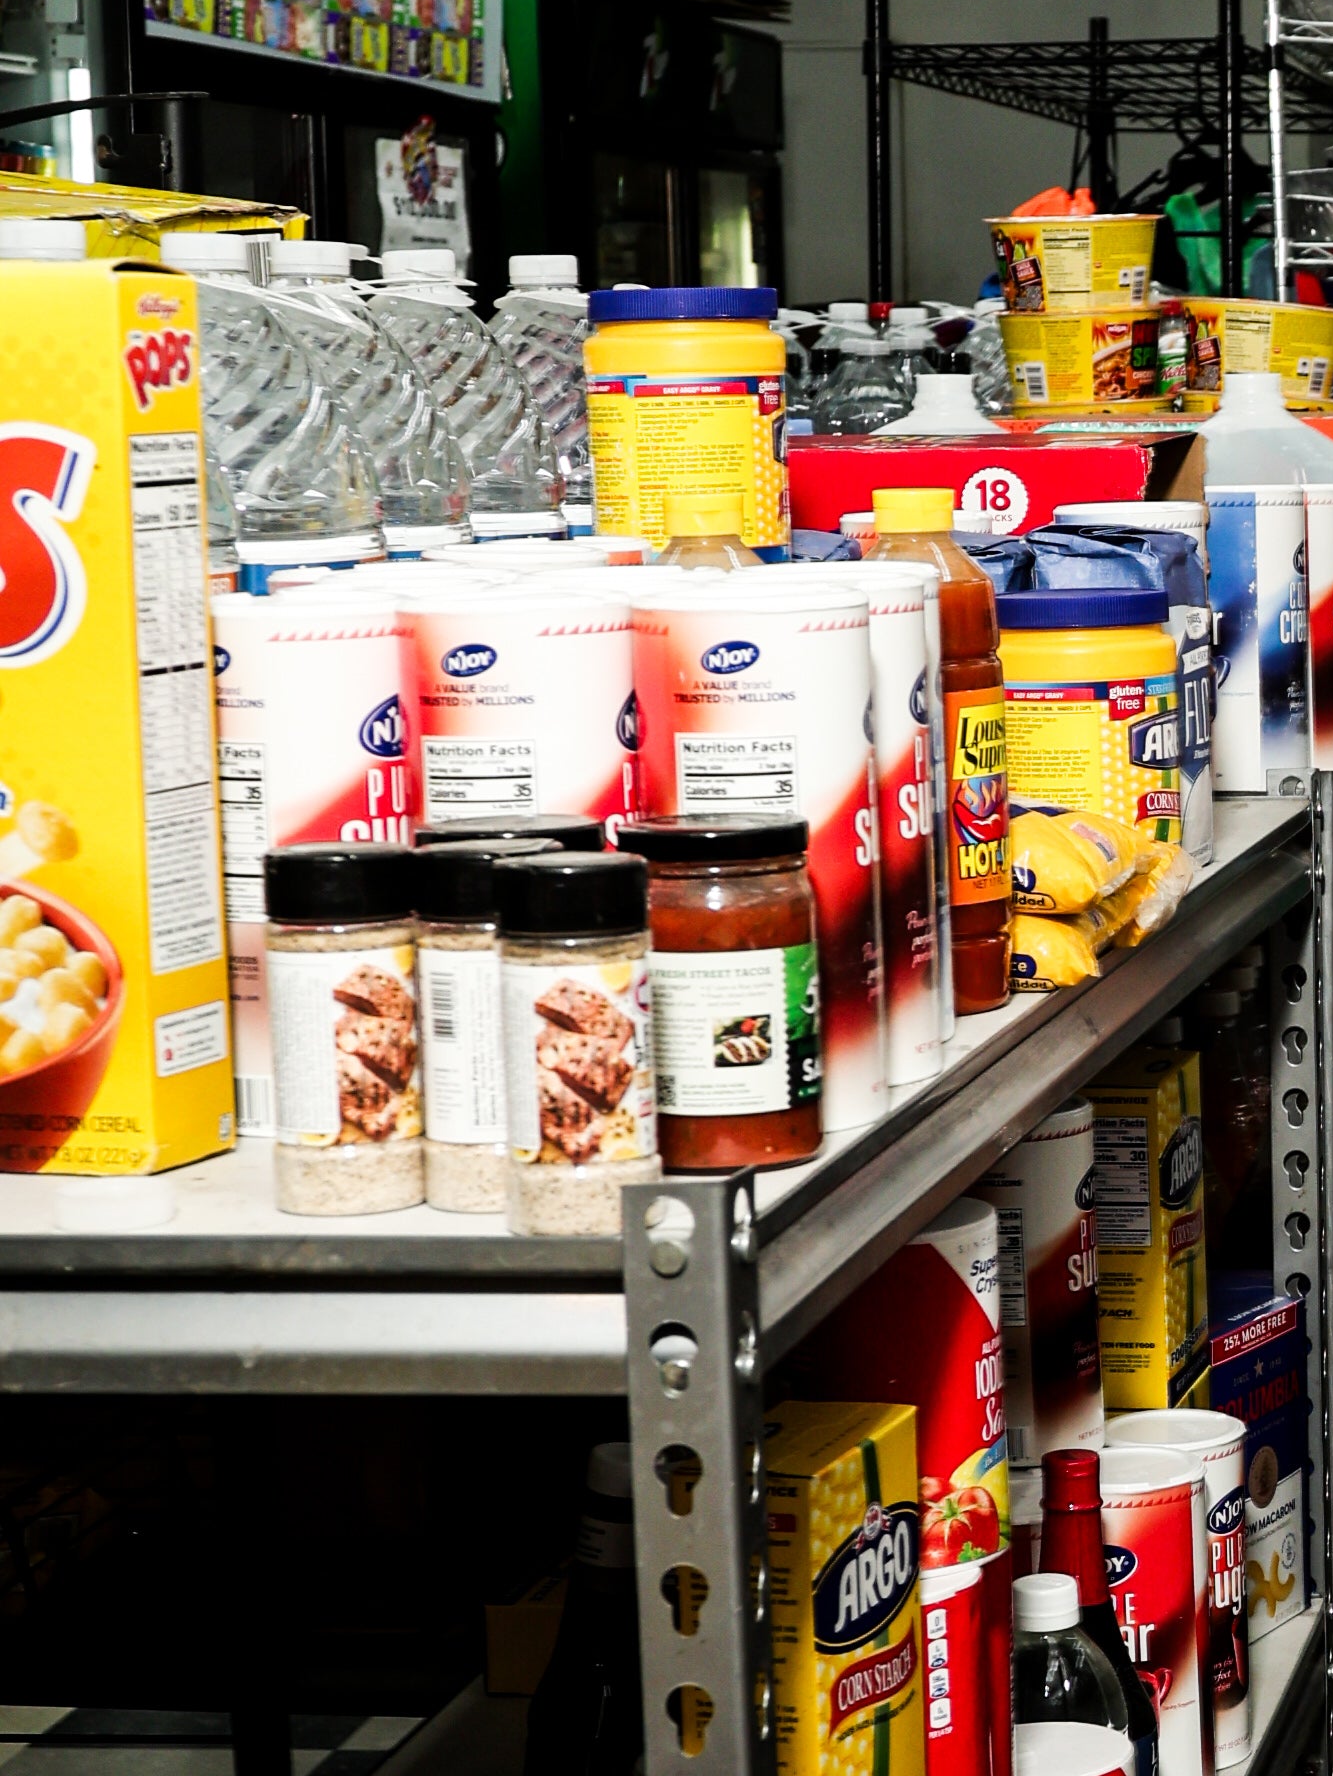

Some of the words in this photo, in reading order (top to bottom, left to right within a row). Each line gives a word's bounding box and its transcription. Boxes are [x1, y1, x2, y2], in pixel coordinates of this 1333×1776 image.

[126, 331, 190, 408] POPS
[976, 480, 1011, 511] 18
[442, 684, 476, 693] VALUE
[703, 681, 738, 690] VALUE
[1109, 685, 1144, 700] gluten-
[476, 696, 535, 705] MILLIONS
[674, 694, 721, 704] TRUSTED
[738, 692, 796, 702] MILLIONS
[1117, 697, 1140, 711] free
[427, 745, 483, 757] Nutrition
[490, 745, 531, 756] Facts
[683, 741, 745, 754] Nutrition
[752, 741, 792, 752] Facts
[513, 785, 532, 797] 35
[685, 785, 727, 796] Calories
[775, 780, 792, 794] 35
[1146, 793, 1171, 809] CORN
[1223, 1331, 1241, 1352] 25%
[1241, 1320, 1265, 1344] MORE
[1266, 1312, 1288, 1334] FREE
[1258, 1498, 1296, 1530] MACARONI
[834, 1520, 912, 1634] ARGO
[838, 1671, 872, 1712] CORN
[873, 1642, 912, 1696] STARCH
